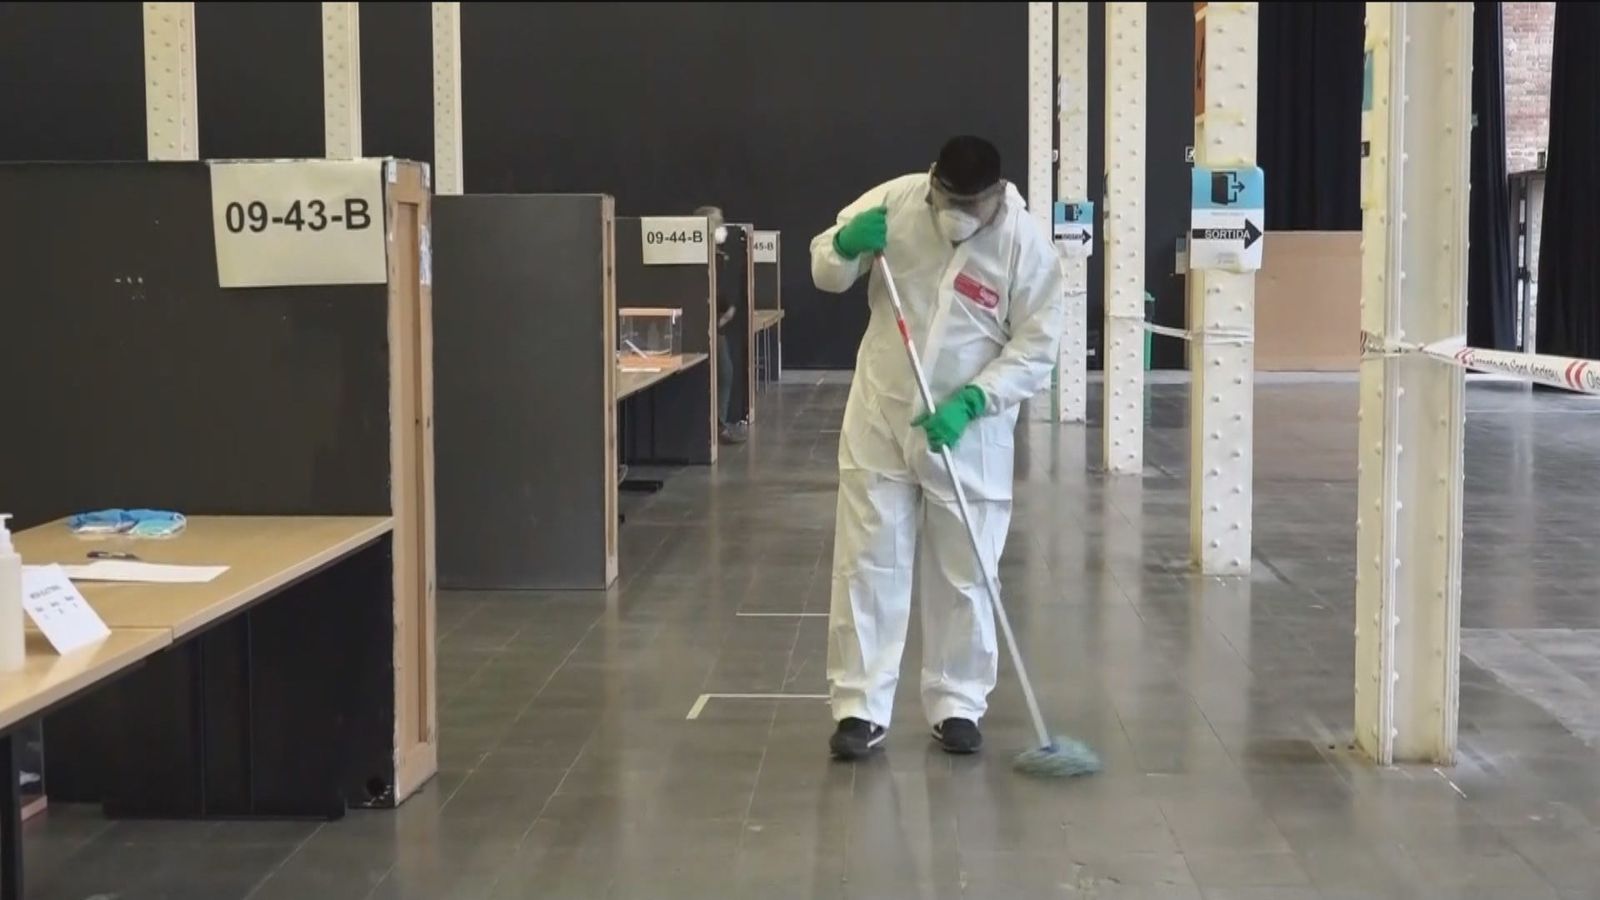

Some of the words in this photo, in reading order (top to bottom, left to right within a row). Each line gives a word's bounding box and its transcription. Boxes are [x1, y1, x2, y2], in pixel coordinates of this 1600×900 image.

[225, 197, 371, 233] 09-43-B
[646, 230, 704, 245] 09-44-B
[1204, 229, 1251, 240] SORTIDA
[753, 242, 774, 251] 45-B
